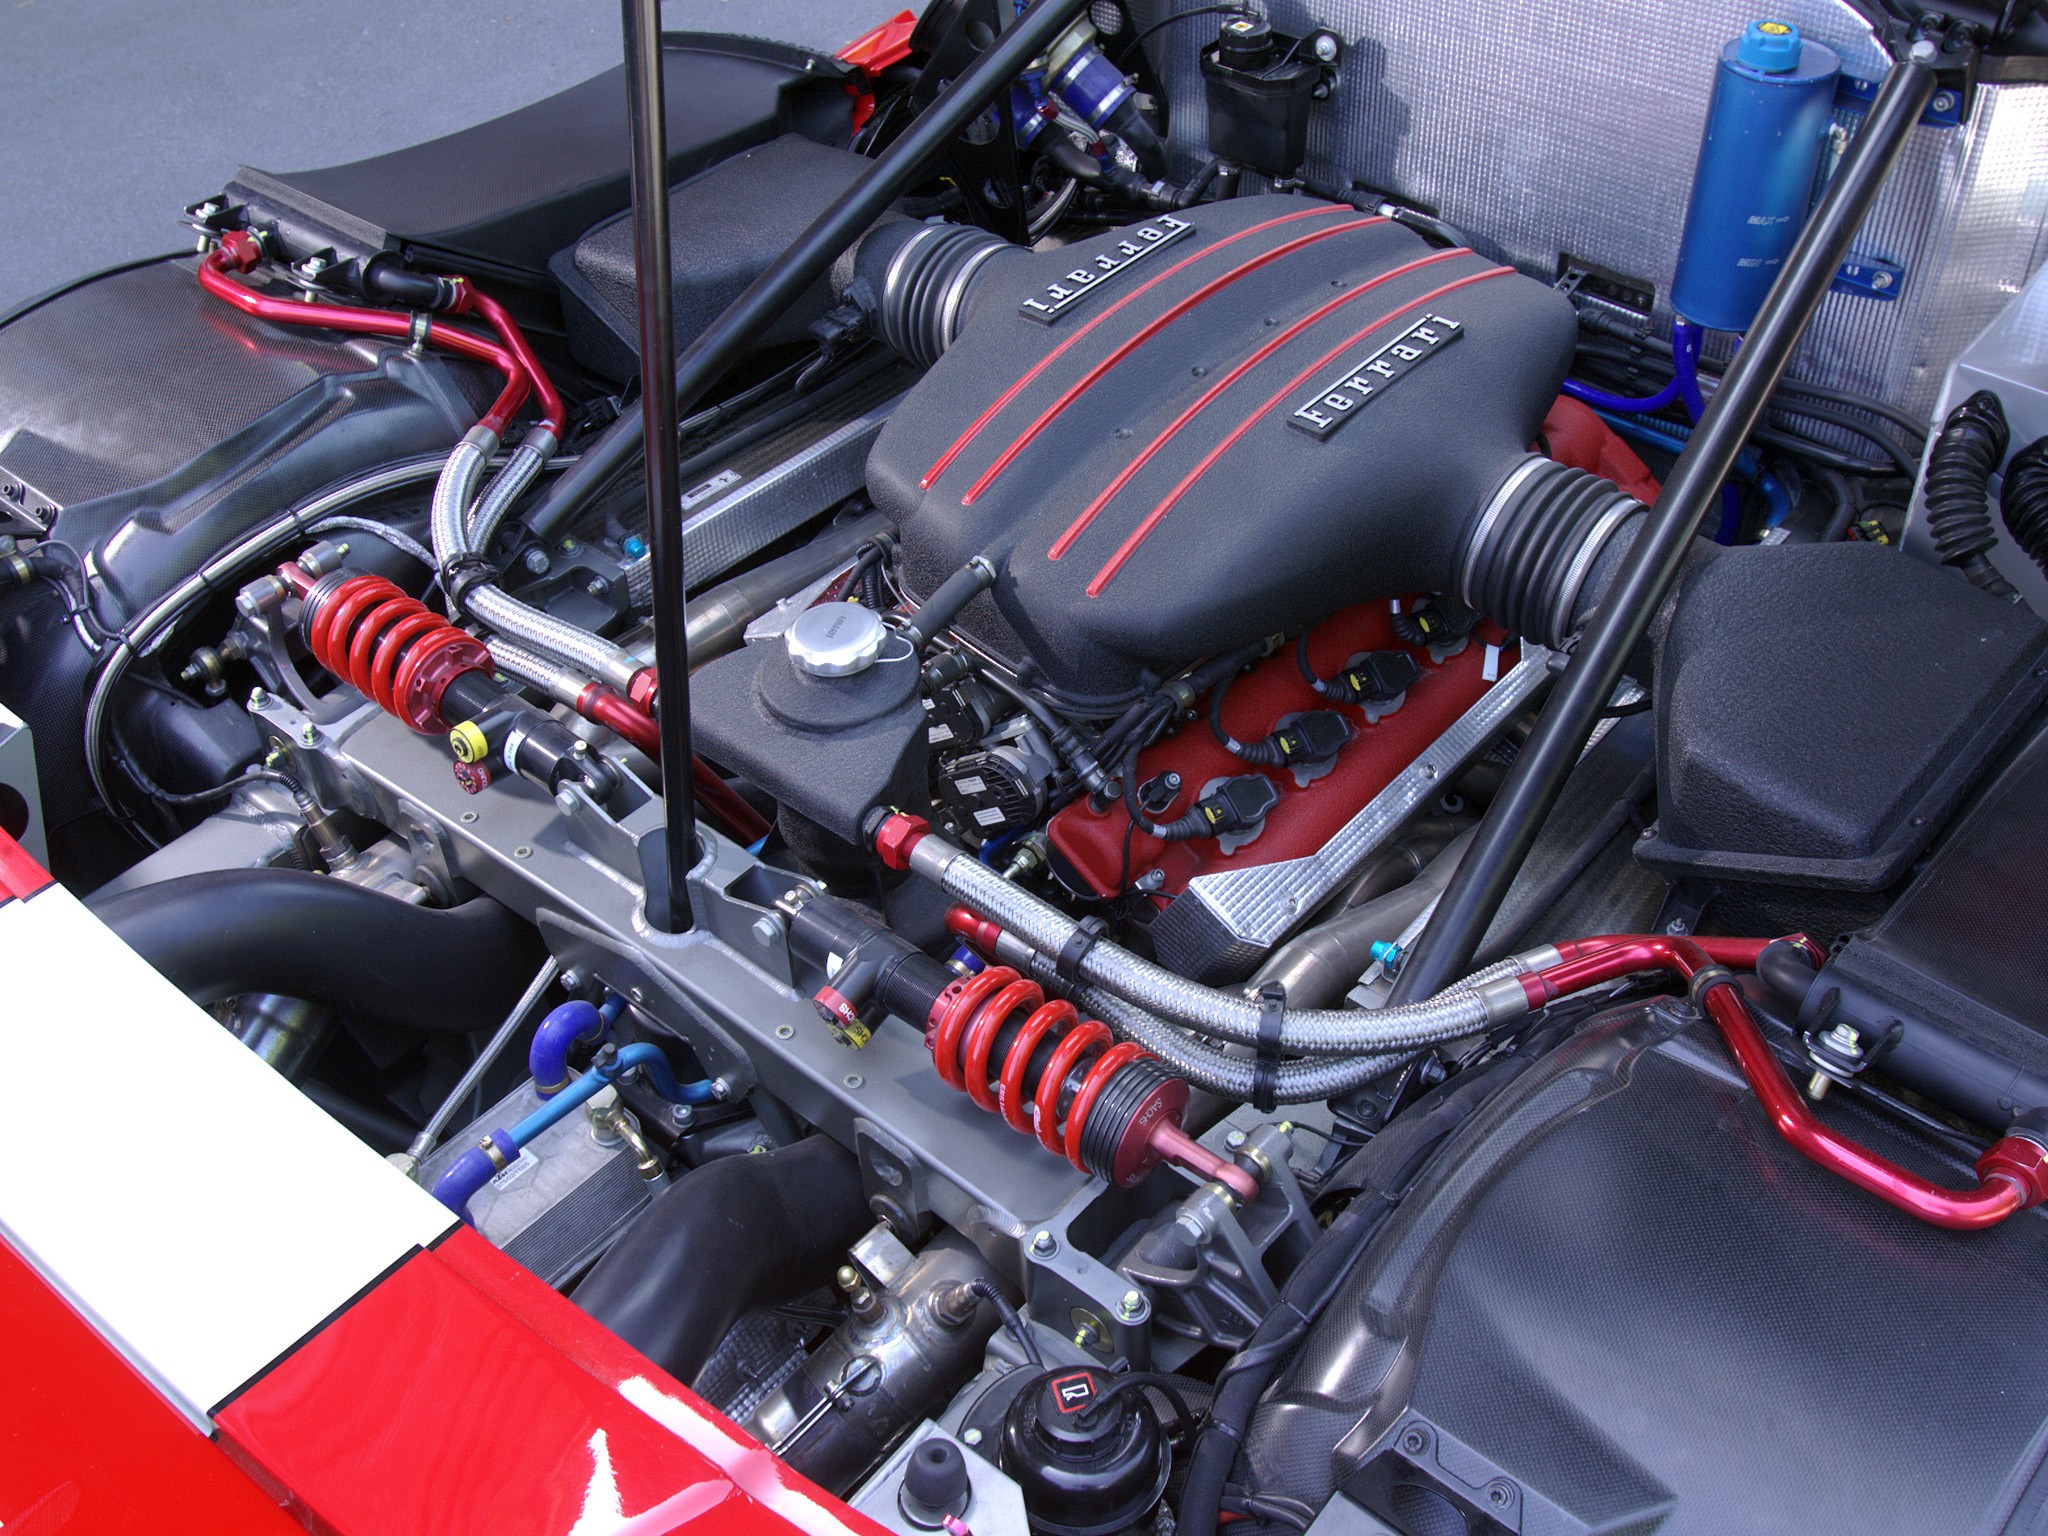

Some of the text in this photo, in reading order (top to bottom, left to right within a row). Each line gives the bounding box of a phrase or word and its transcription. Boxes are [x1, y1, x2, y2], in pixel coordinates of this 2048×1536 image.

[1747, 216, 1776, 225] MAX
[1023, 214, 1191, 313] Ferrari
[1294, 314, 1460, 428] Ferrari
[1139, 1098, 1163, 1127] SACHS
